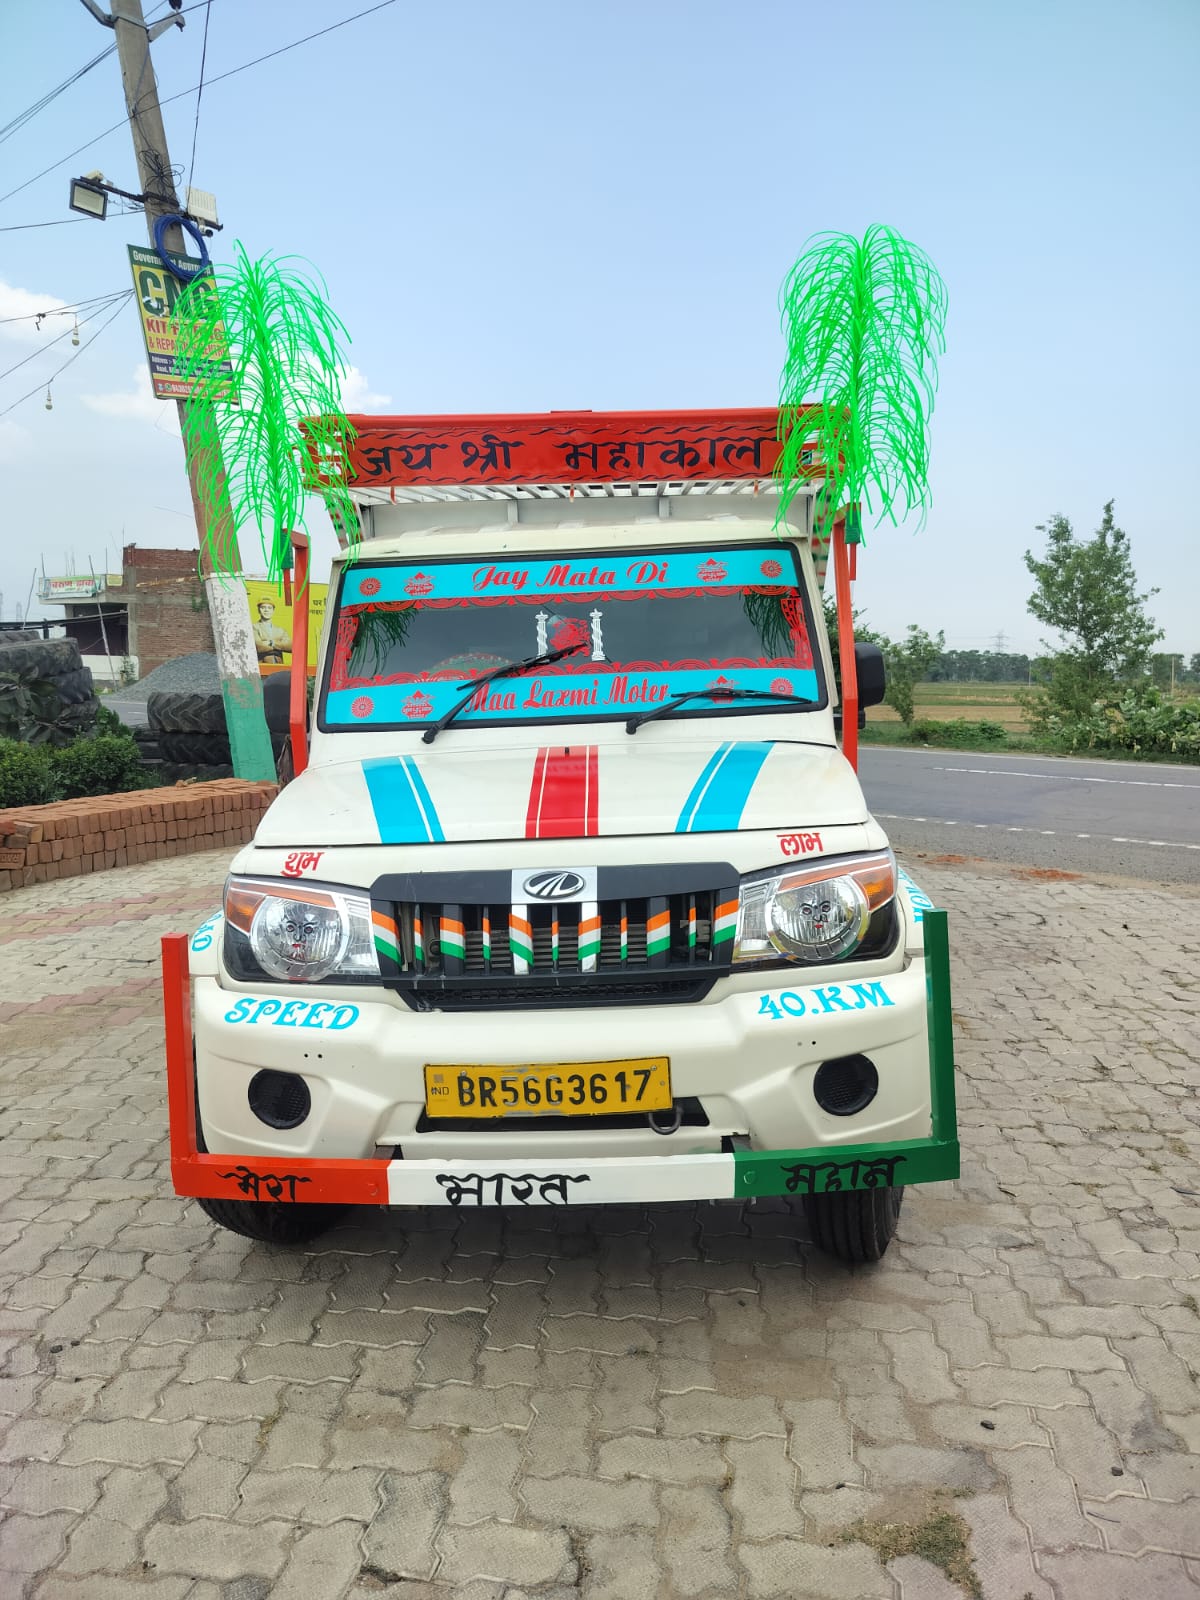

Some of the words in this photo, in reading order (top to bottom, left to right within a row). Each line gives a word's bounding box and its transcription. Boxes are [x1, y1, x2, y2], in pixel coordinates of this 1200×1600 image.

[146, 318, 167, 334] KIT
[358, 443, 448, 475] जय
[460, 434, 524, 474] श्री
[552, 436, 782, 473] महाकाल
[472, 565, 531, 591] Jay
[536, 564, 619, 587] Mata
[626, 561, 669, 584] Di
[464, 682, 516, 713] Maa
[523, 680, 599, 709] Laxmi
[603, 675, 669, 705] Moter
[776, 832, 824, 856] लाभ
[281, 852, 324, 878] शुभ
[224, 998, 360, 1030] SPEED
[457, 1069, 652, 1108] BR56G3617
[435, 1173, 591, 1206] भारत
[780, 1155, 906, 1194] महान
